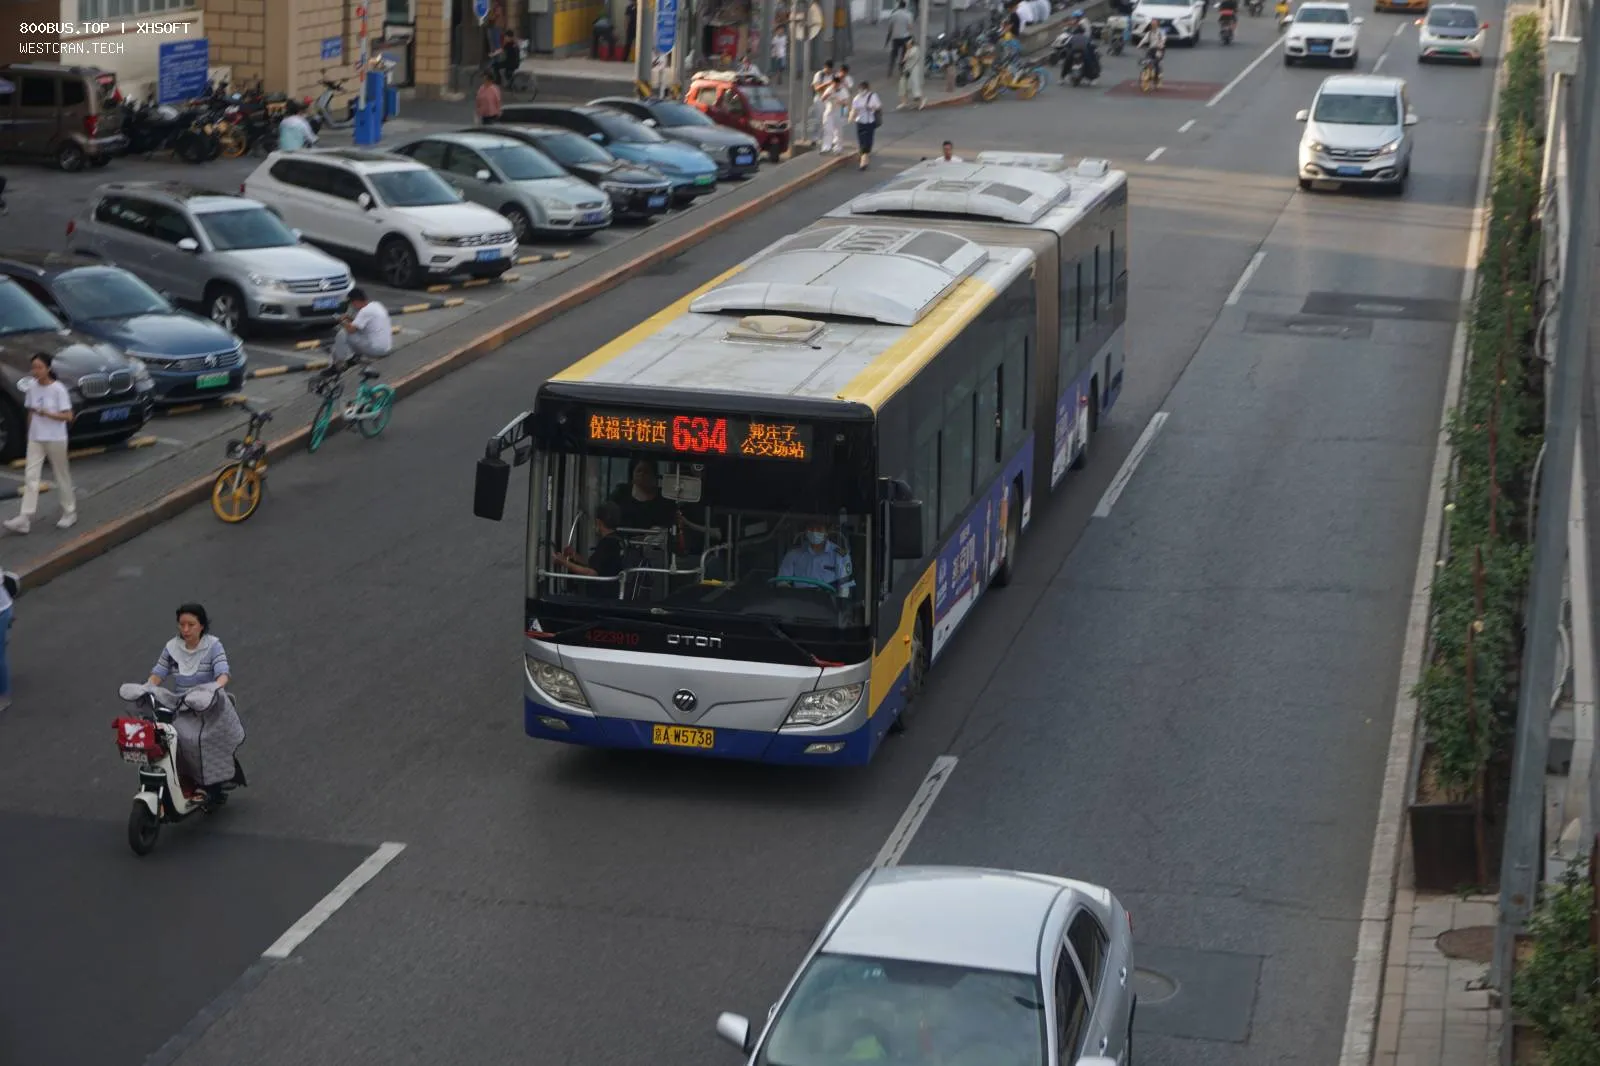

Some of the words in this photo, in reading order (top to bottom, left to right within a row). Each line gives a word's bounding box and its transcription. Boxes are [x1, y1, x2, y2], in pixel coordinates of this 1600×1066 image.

[589, 414, 667, 444] 保福寺桥西
[672, 415, 729, 454] 634
[749, 422, 798, 441] 郭庄子
[740, 437, 806, 459] 公交场站
